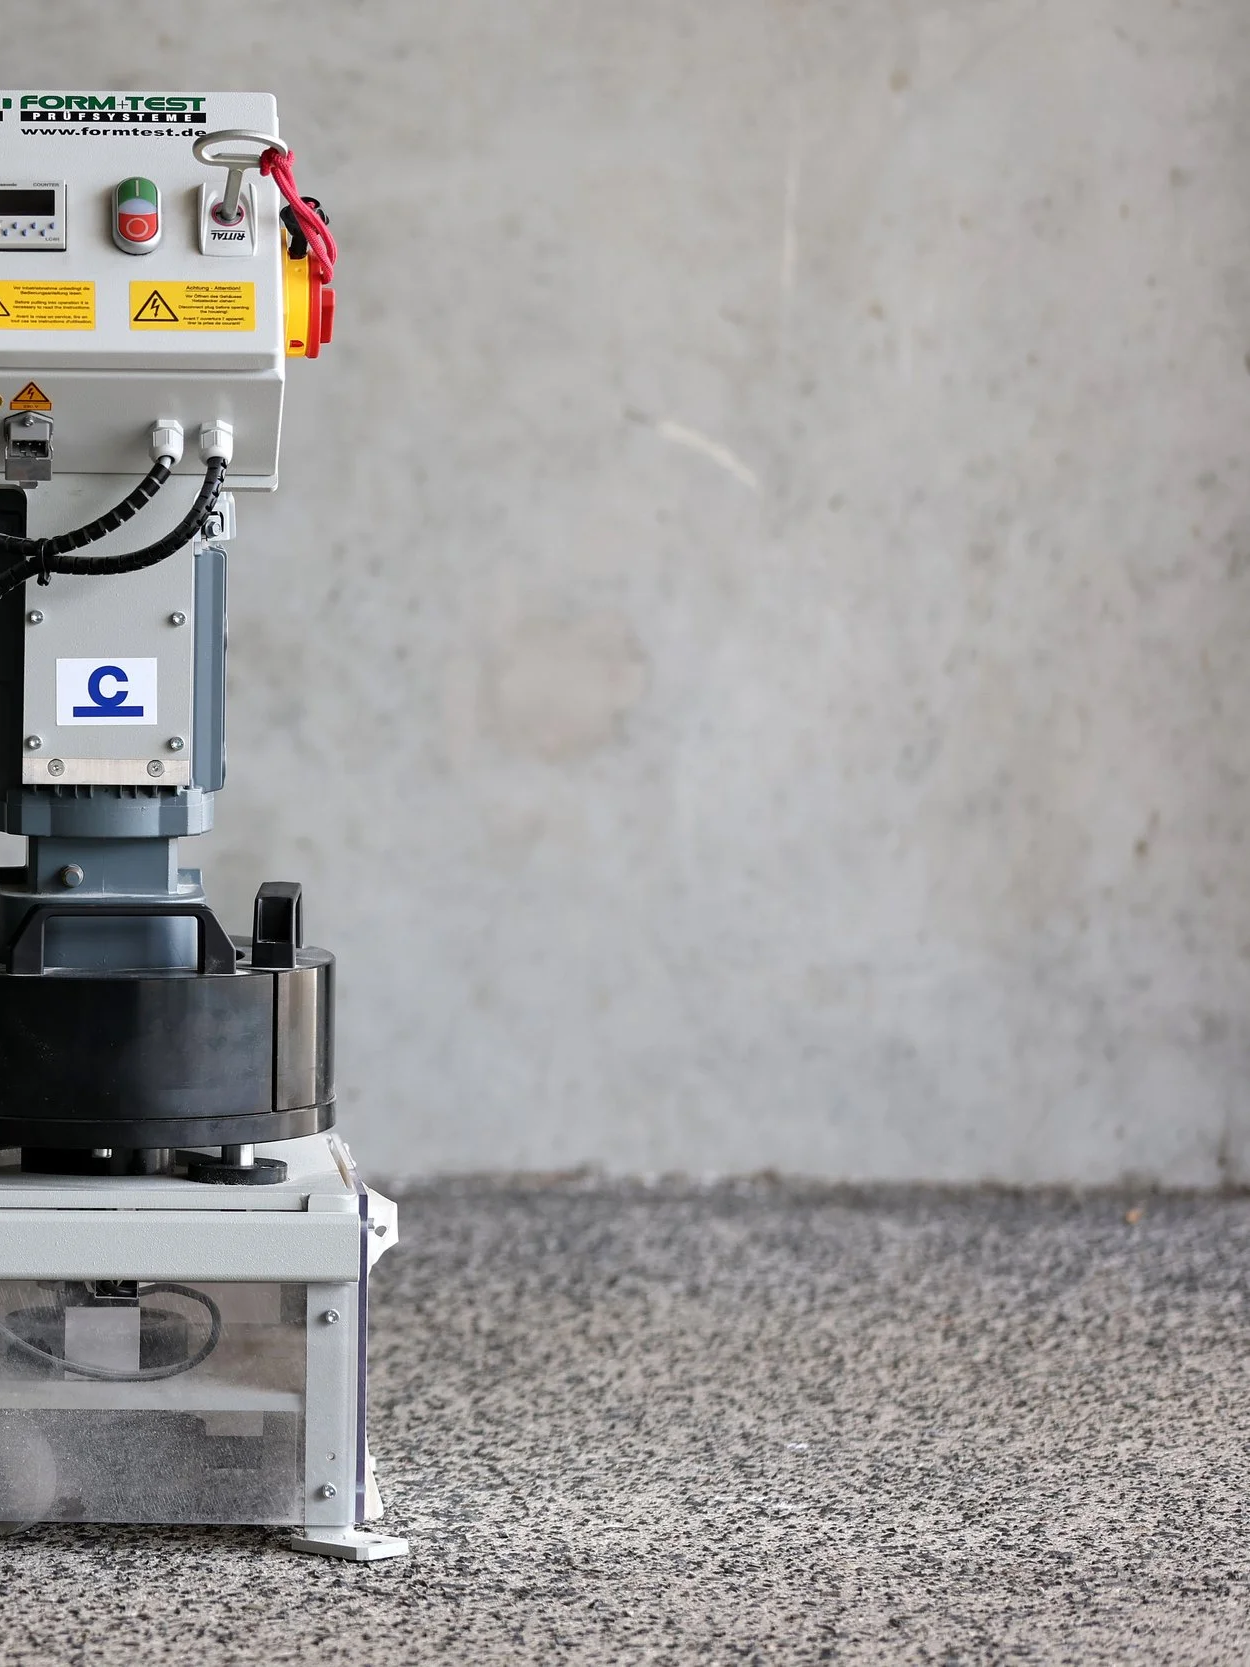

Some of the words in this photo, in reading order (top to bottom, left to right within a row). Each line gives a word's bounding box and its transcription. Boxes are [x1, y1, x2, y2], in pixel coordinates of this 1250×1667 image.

[20, 95, 206, 112] FORM+TEST
[32, 110, 192, 122] PRÜFSYSTEME
[21, 126, 207, 137] www.formtest.de
[210, 232, 245, 241] RITTAL
